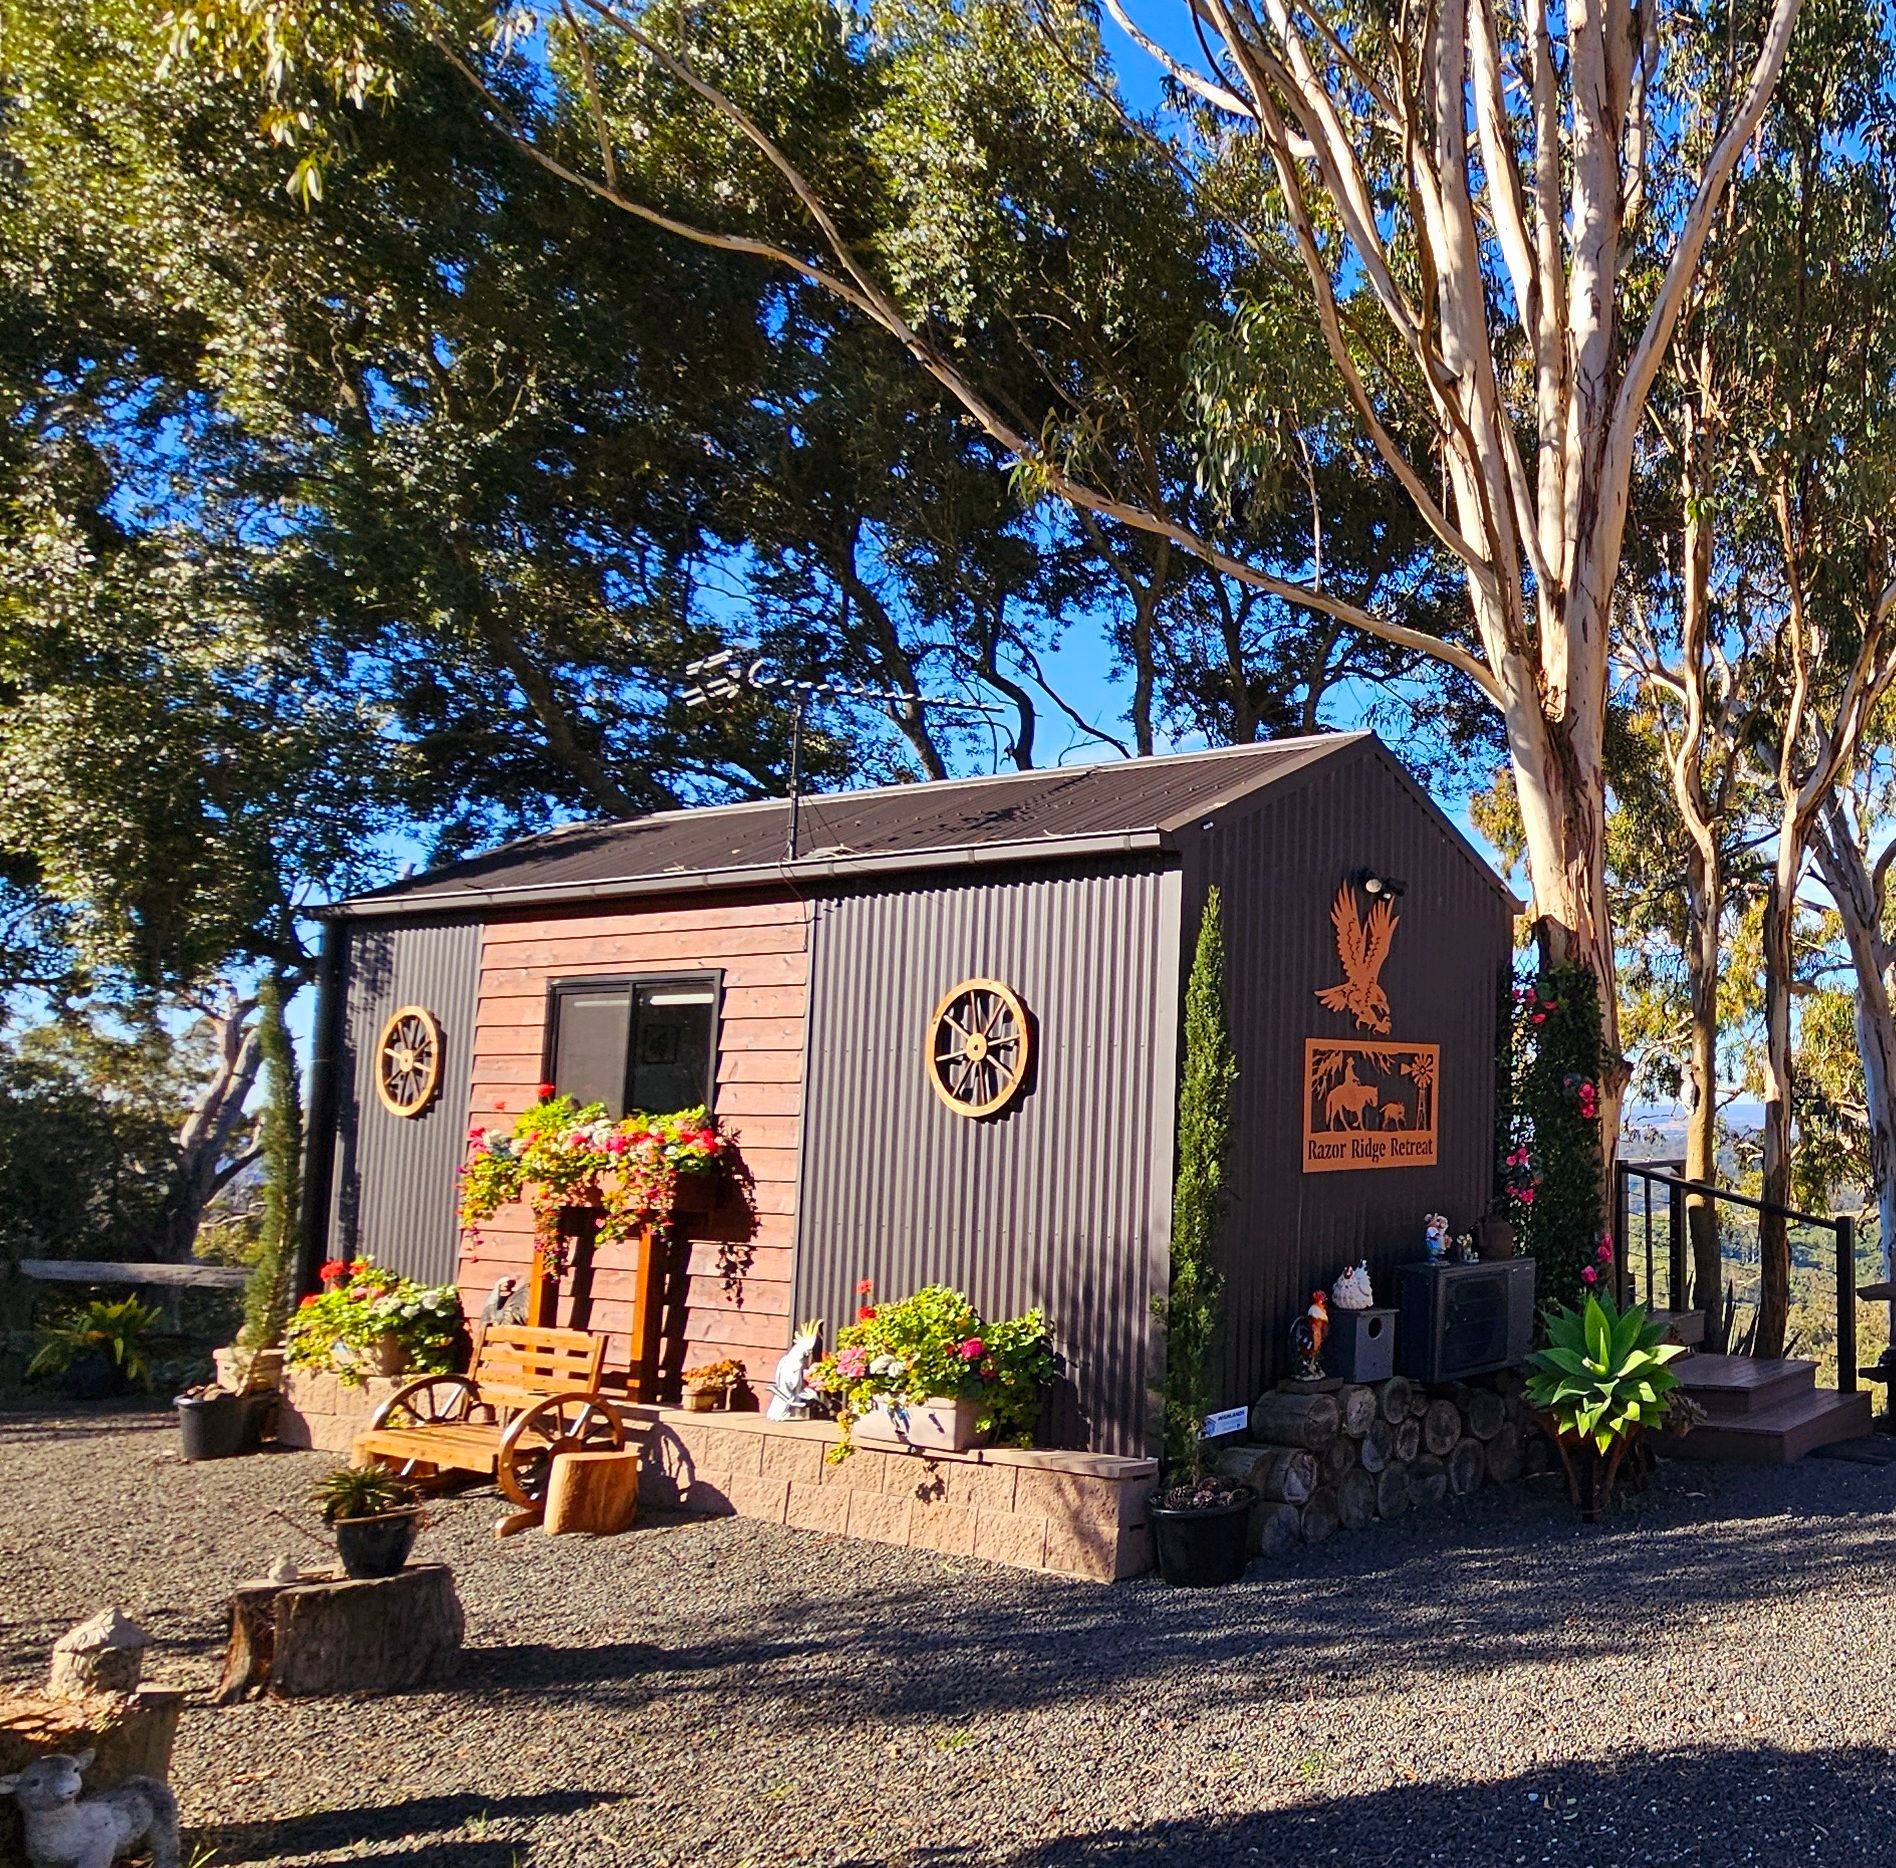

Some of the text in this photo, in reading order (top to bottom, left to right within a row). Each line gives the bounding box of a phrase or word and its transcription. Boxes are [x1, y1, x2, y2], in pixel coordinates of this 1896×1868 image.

[1308, 1137, 1434, 1163] Razor Ridge Retreat
